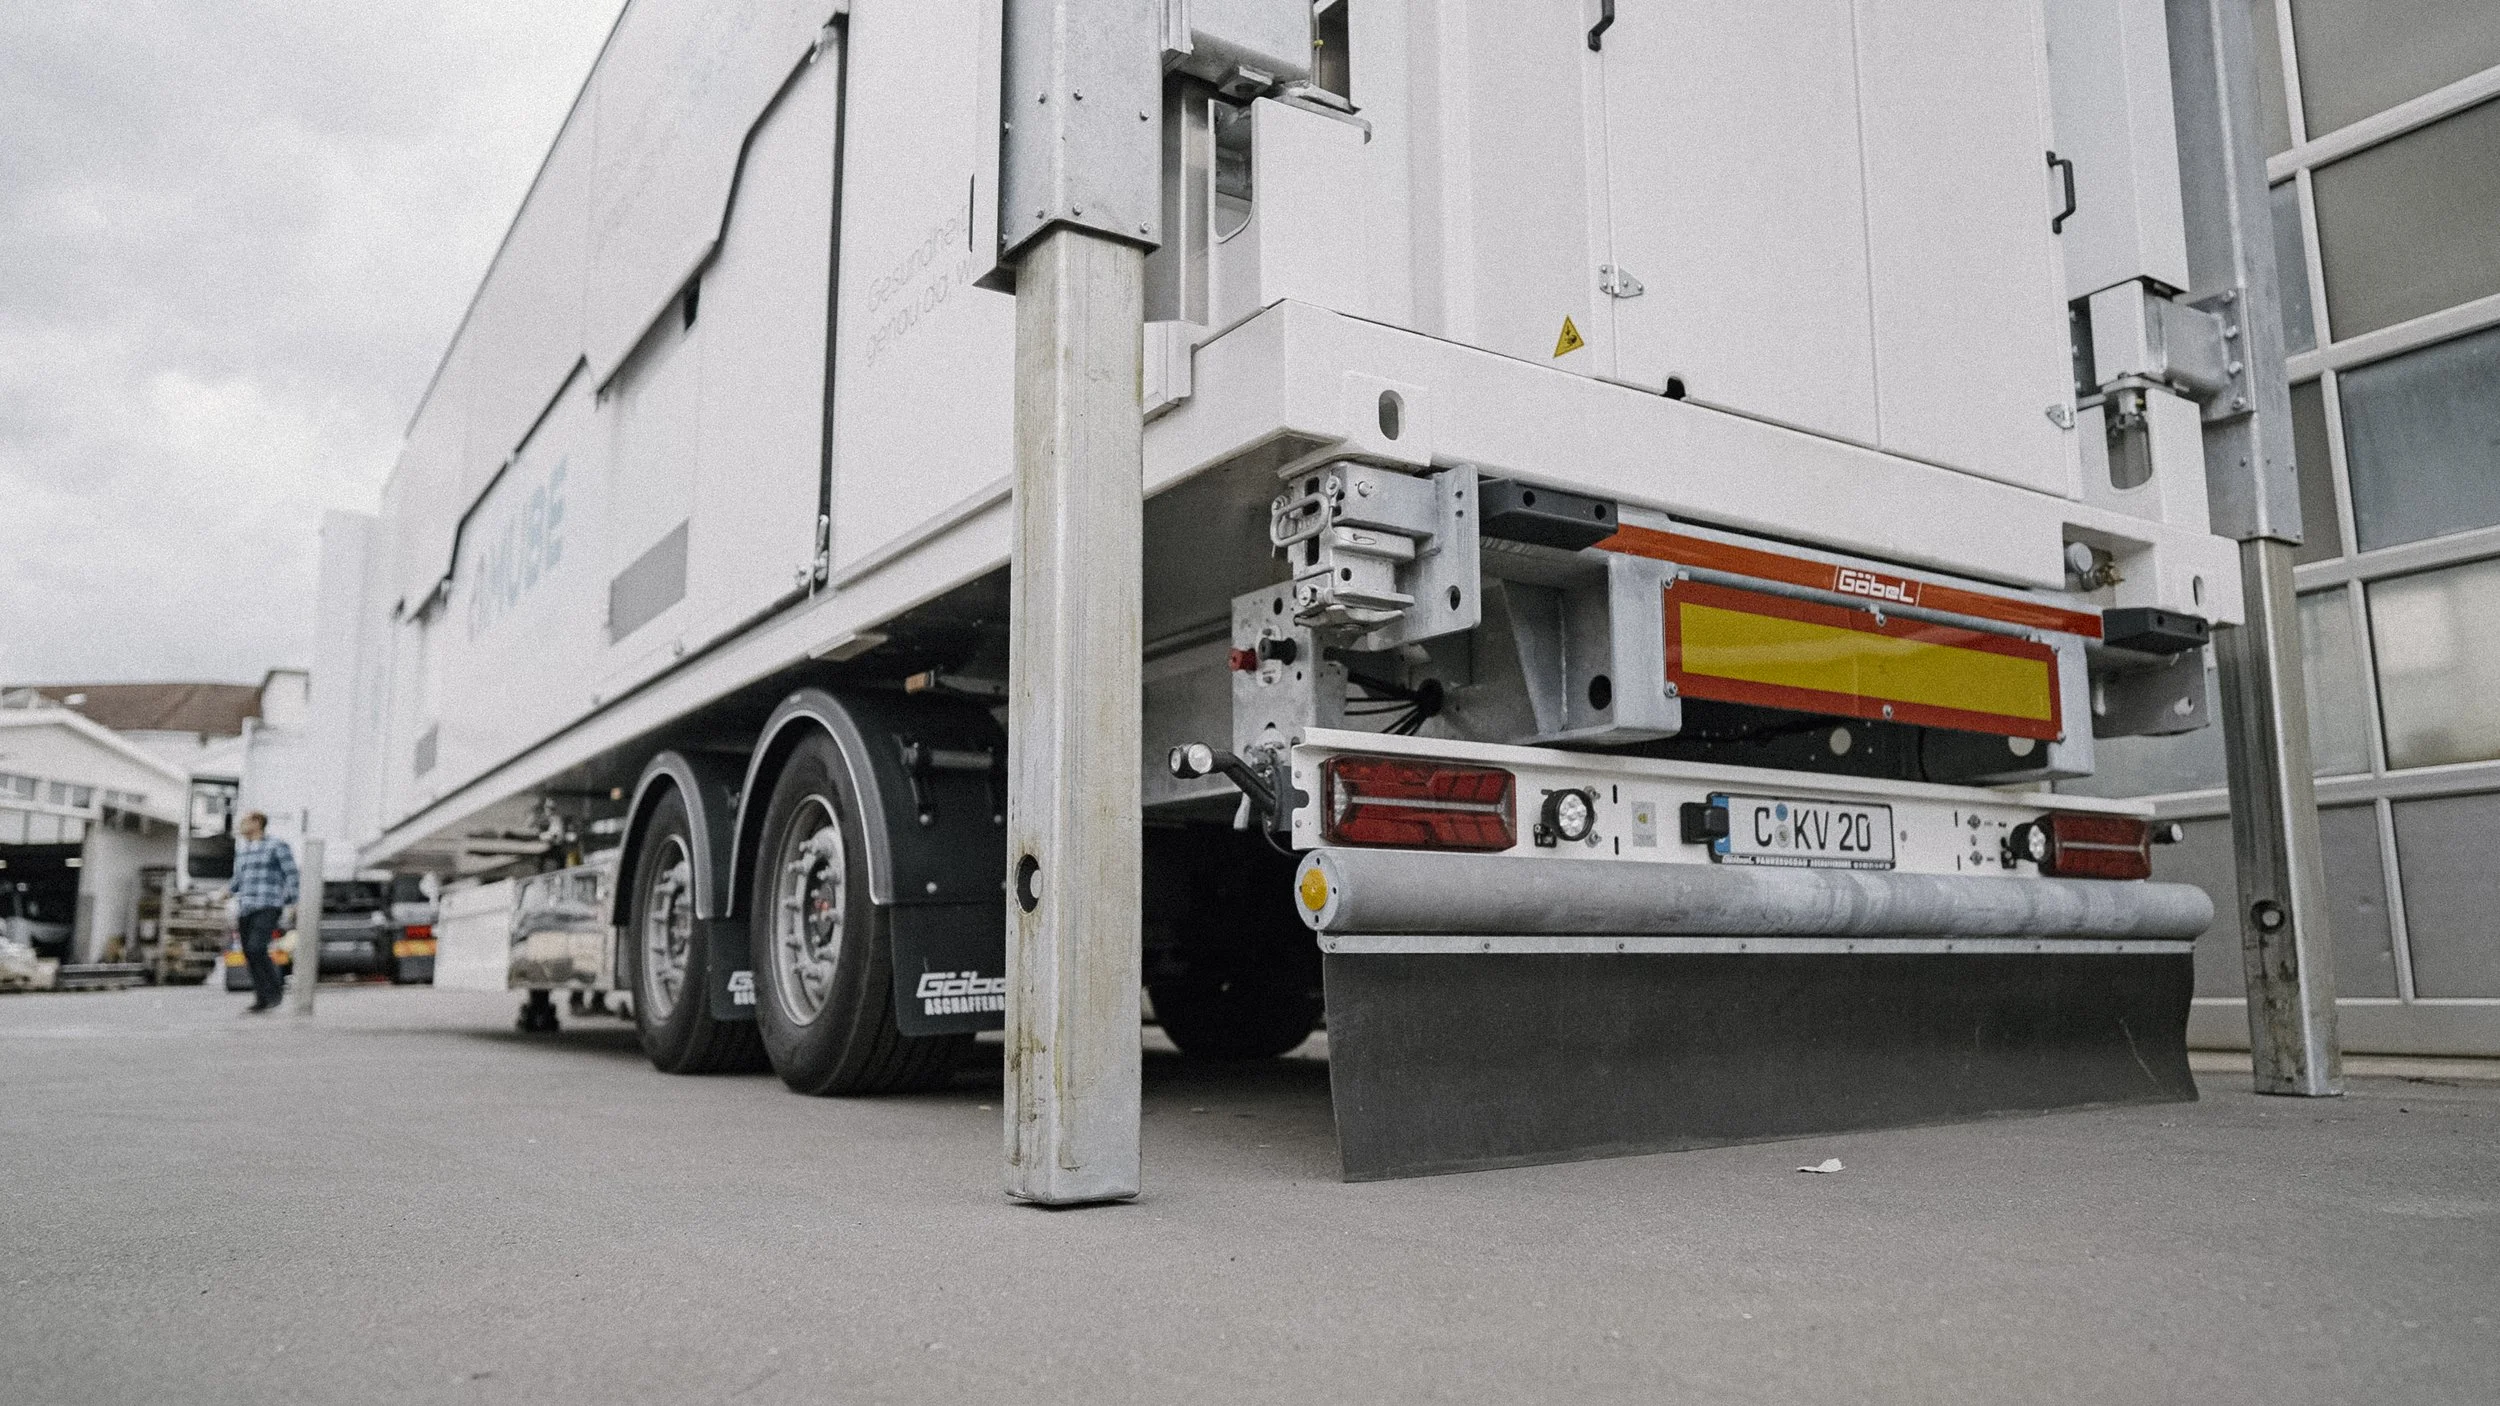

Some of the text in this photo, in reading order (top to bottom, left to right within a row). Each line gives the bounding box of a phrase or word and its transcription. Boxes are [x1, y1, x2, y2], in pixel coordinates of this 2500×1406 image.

[1754, 807, 1871, 852] C KV 20
